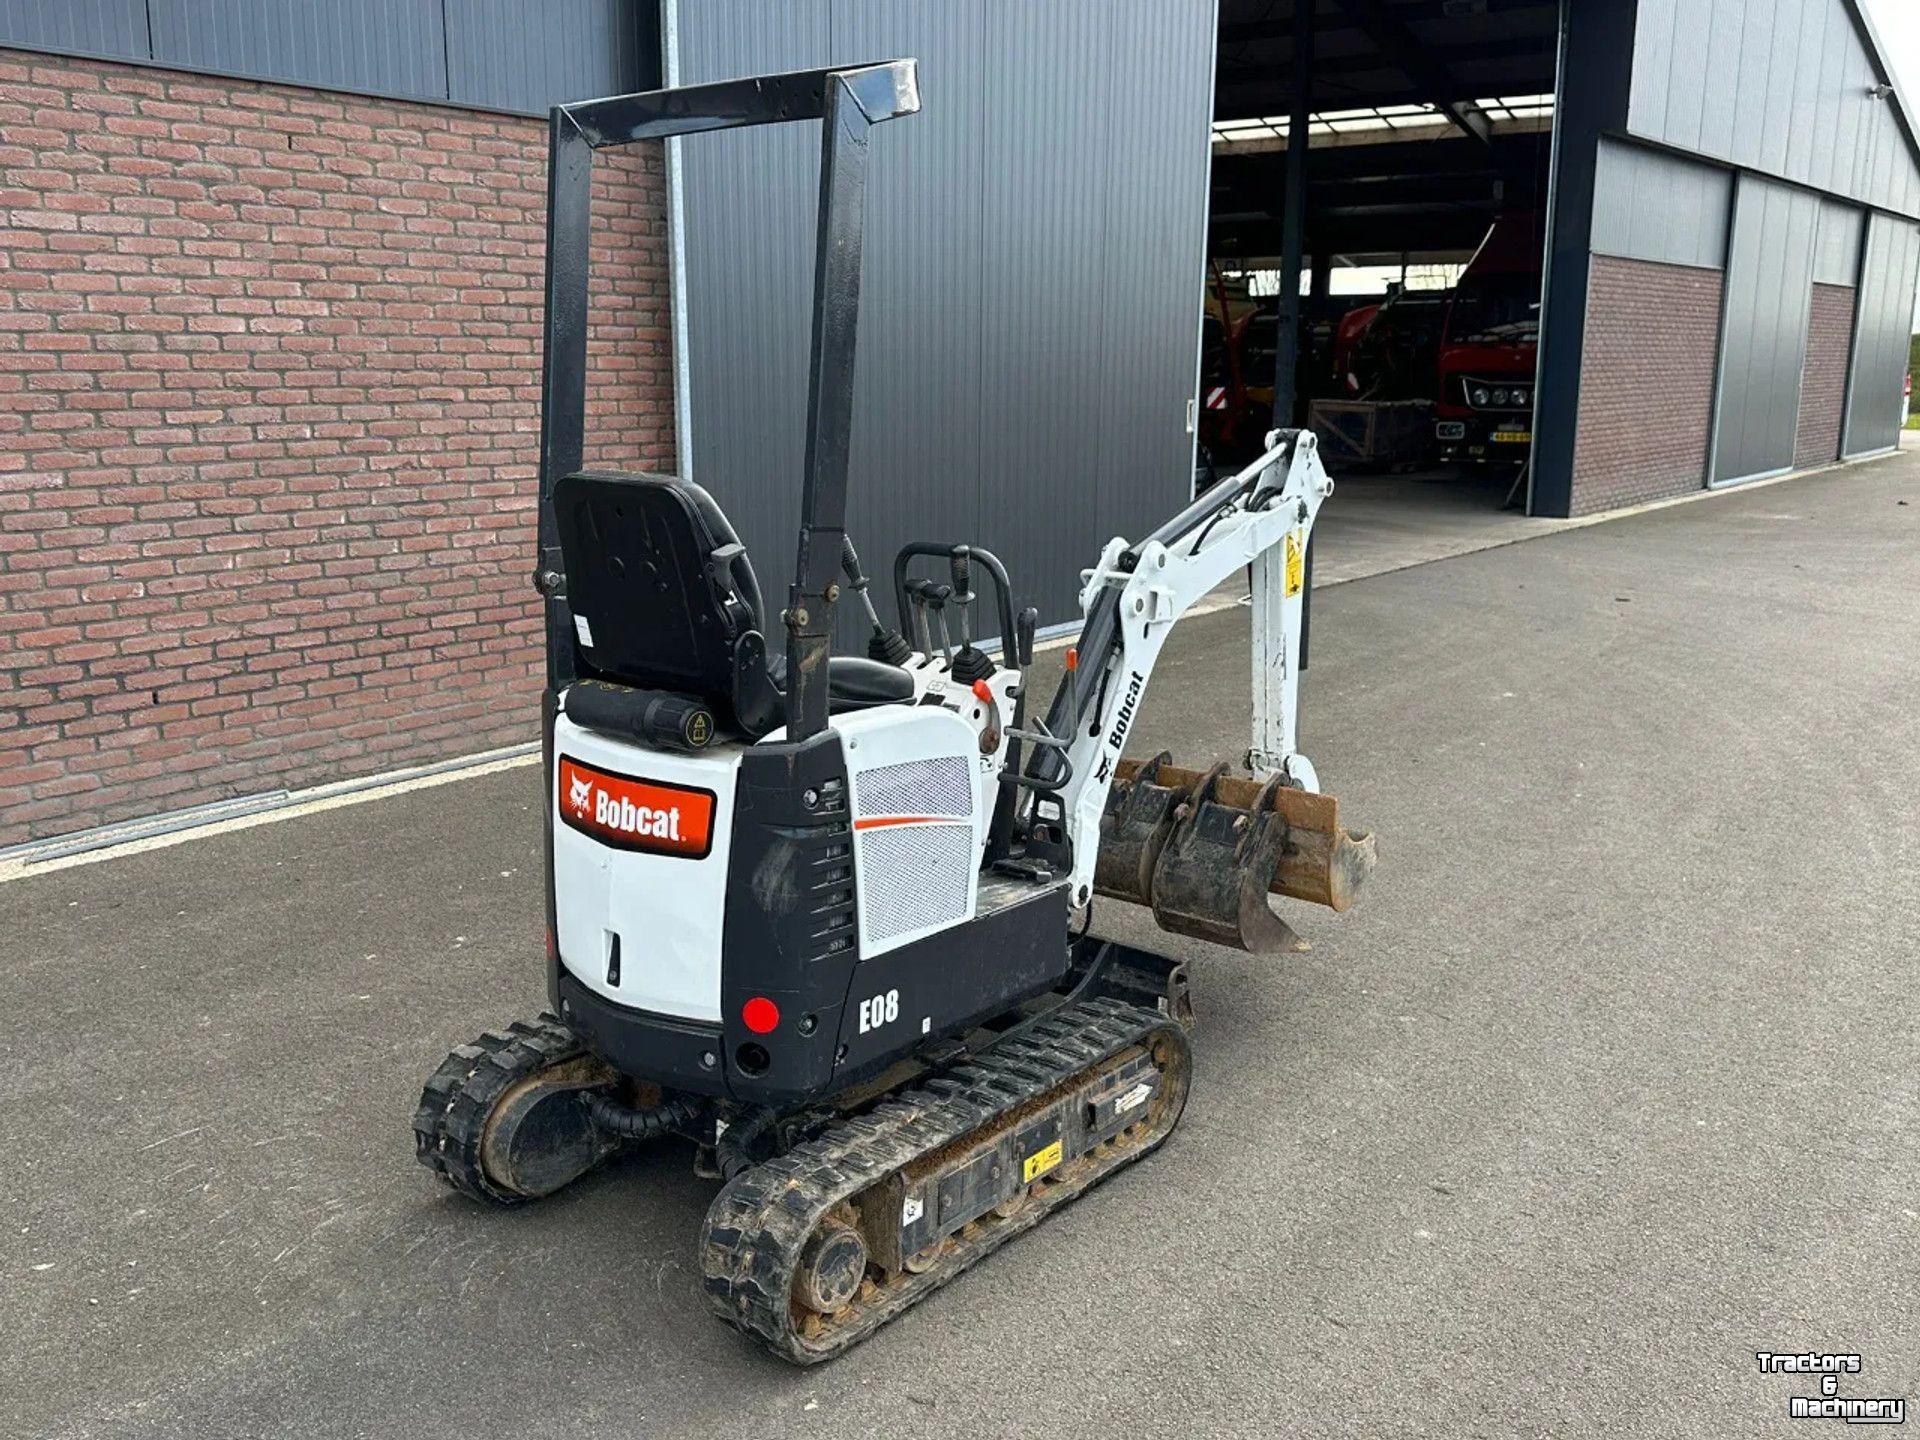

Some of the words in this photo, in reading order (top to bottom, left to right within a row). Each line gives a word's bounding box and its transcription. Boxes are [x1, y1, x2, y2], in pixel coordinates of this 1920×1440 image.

[1108, 670, 1144, 750] Bobcat
[595, 788, 680, 842] Bobcat
[859, 989, 900, 1035] E08
